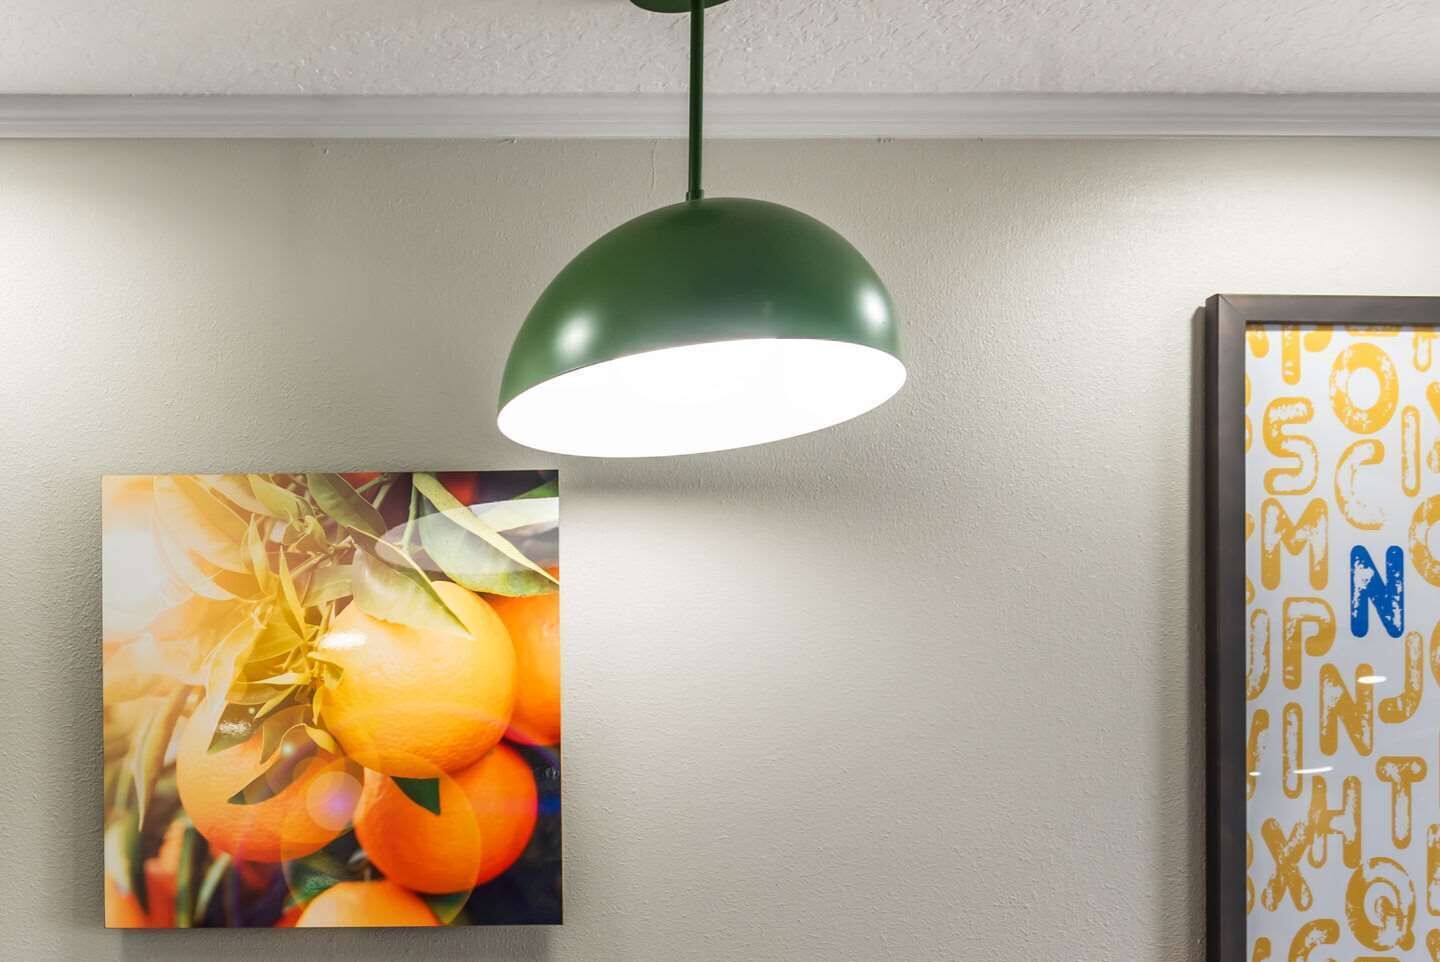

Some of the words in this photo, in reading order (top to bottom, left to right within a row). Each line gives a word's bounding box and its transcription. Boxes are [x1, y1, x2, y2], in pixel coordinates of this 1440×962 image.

[1329, 343, 1399, 434] O
[1262, 397, 1319, 495] S
[1334, 438, 1384, 530] C
[1261, 498, 1328, 590] M
[1350, 545, 1404, 638] N
[1282, 597, 1336, 689] P
[1378, 632, 1423, 723] J
[1320, 663, 1374, 756] N
[1307, 776, 1361, 868] H
[1376, 756, 1427, 849] T
[1261, 818, 1313, 912] X
[1345, 857, 1416, 951] Q
